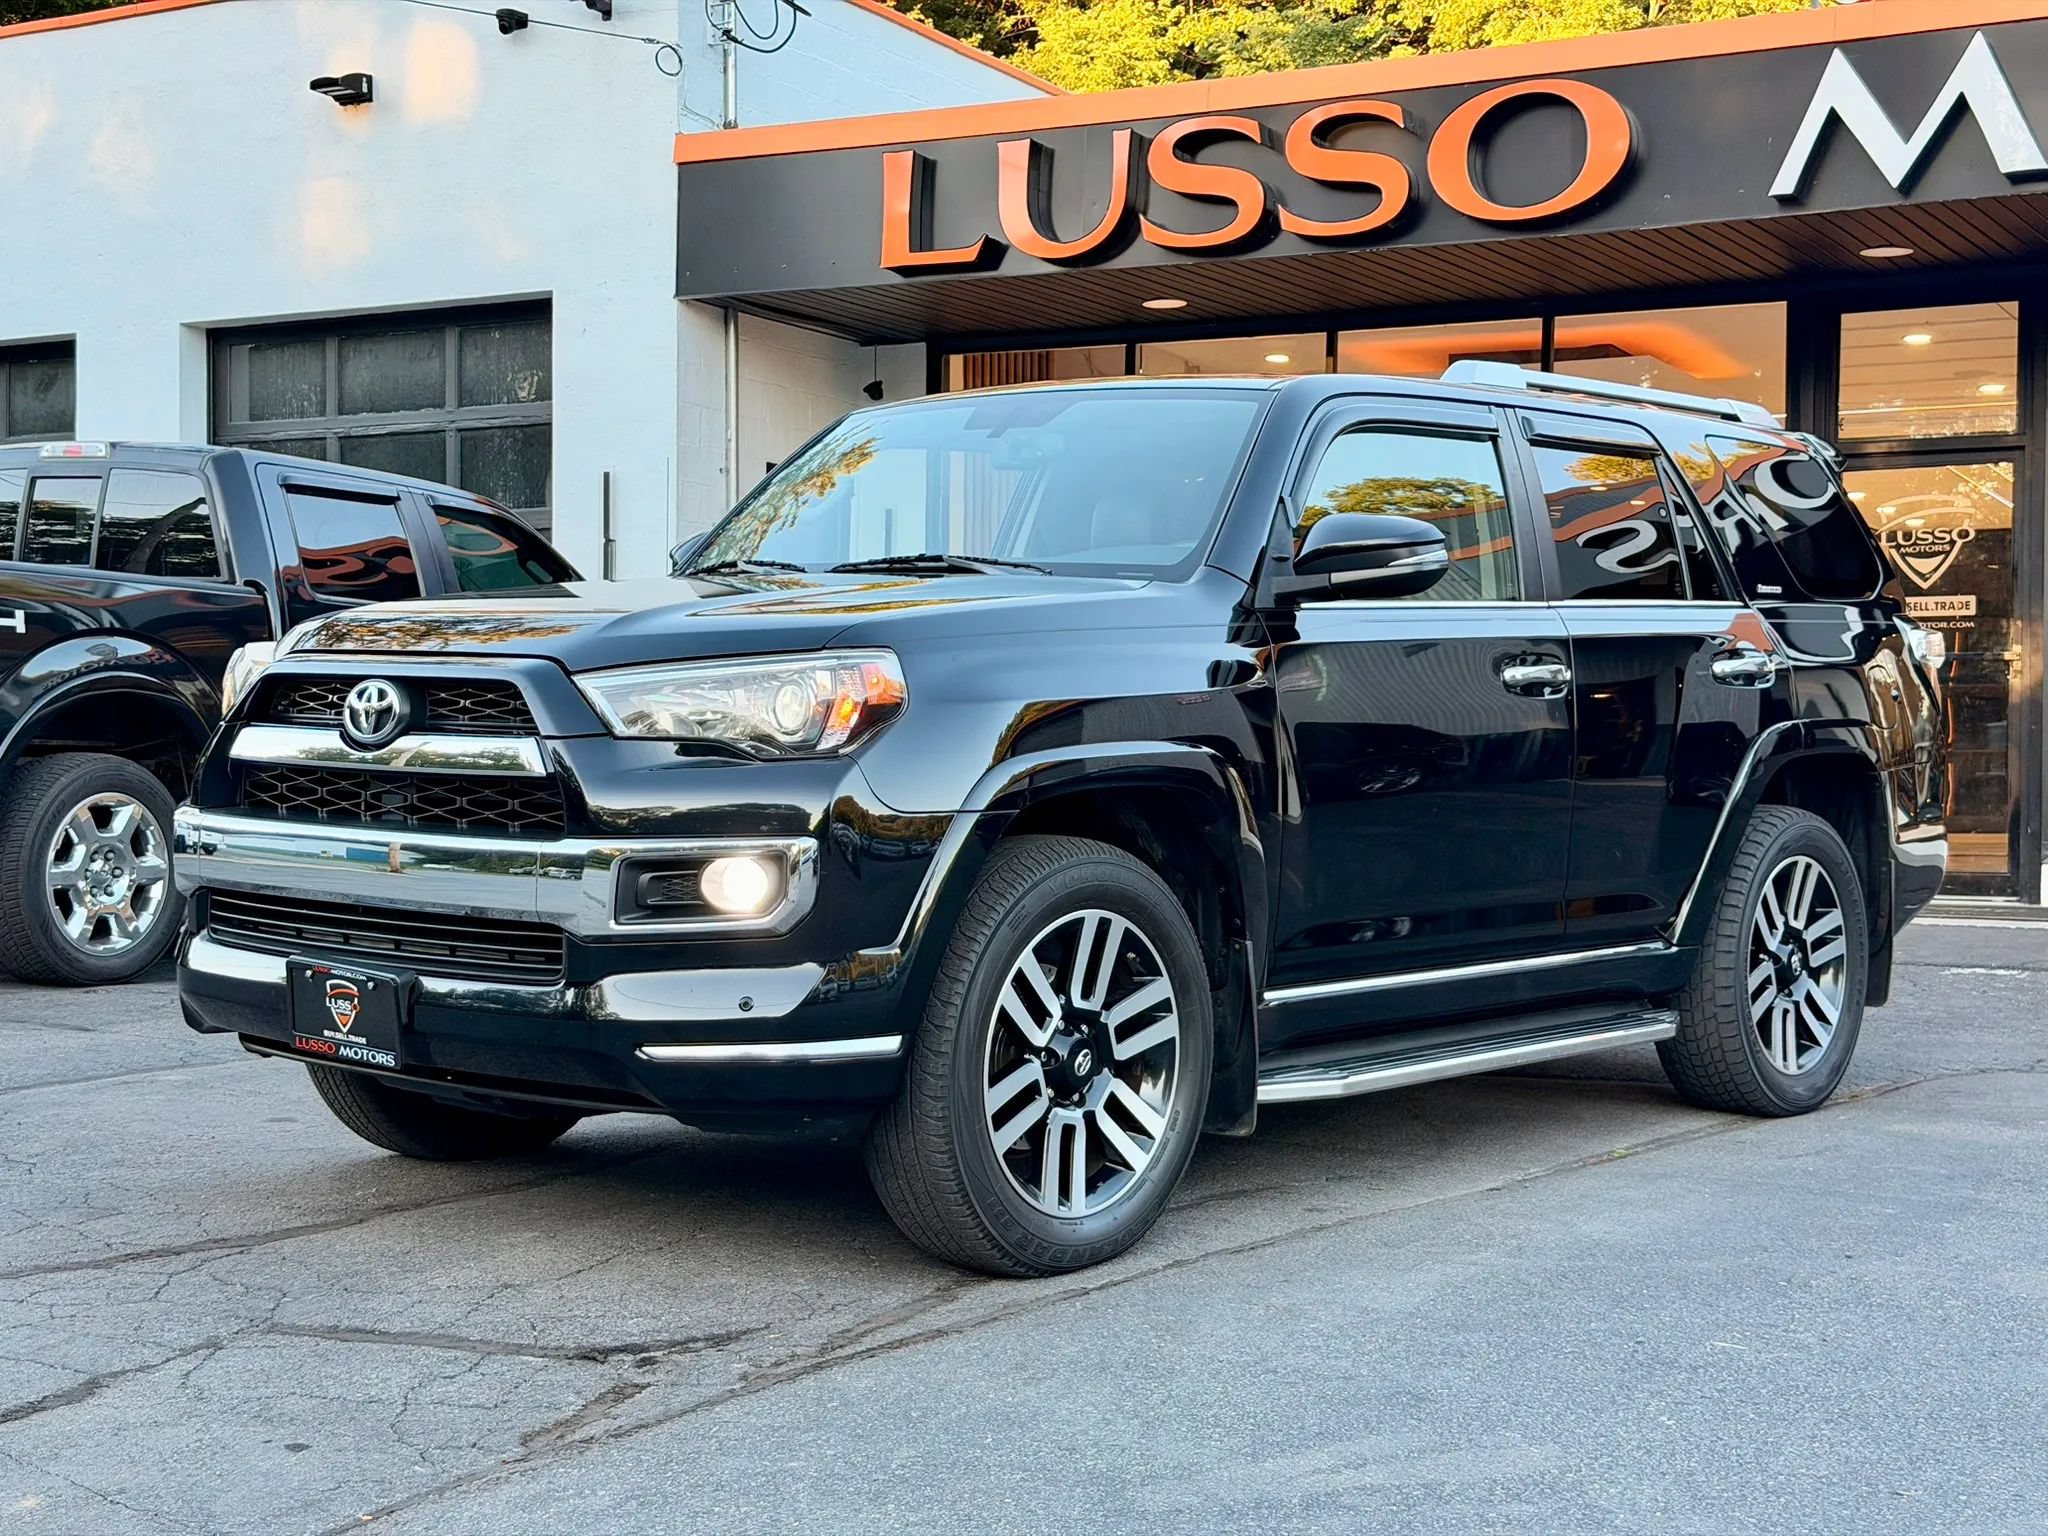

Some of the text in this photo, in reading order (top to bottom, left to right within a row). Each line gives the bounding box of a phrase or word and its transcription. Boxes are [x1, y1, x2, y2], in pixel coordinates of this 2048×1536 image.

[880, 29, 2048, 270] LUSSO M
[1880, 526, 1976, 547] LUSSO
[1899, 544, 1951, 554] MOTORS
[1906, 601, 1971, 612] SELL.TRADE
[1920, 621, 1975, 629] OTOR.COM
[326, 997, 360, 1012] LUSSO
[296, 1036, 396, 1067] LUSSO MOTORS
